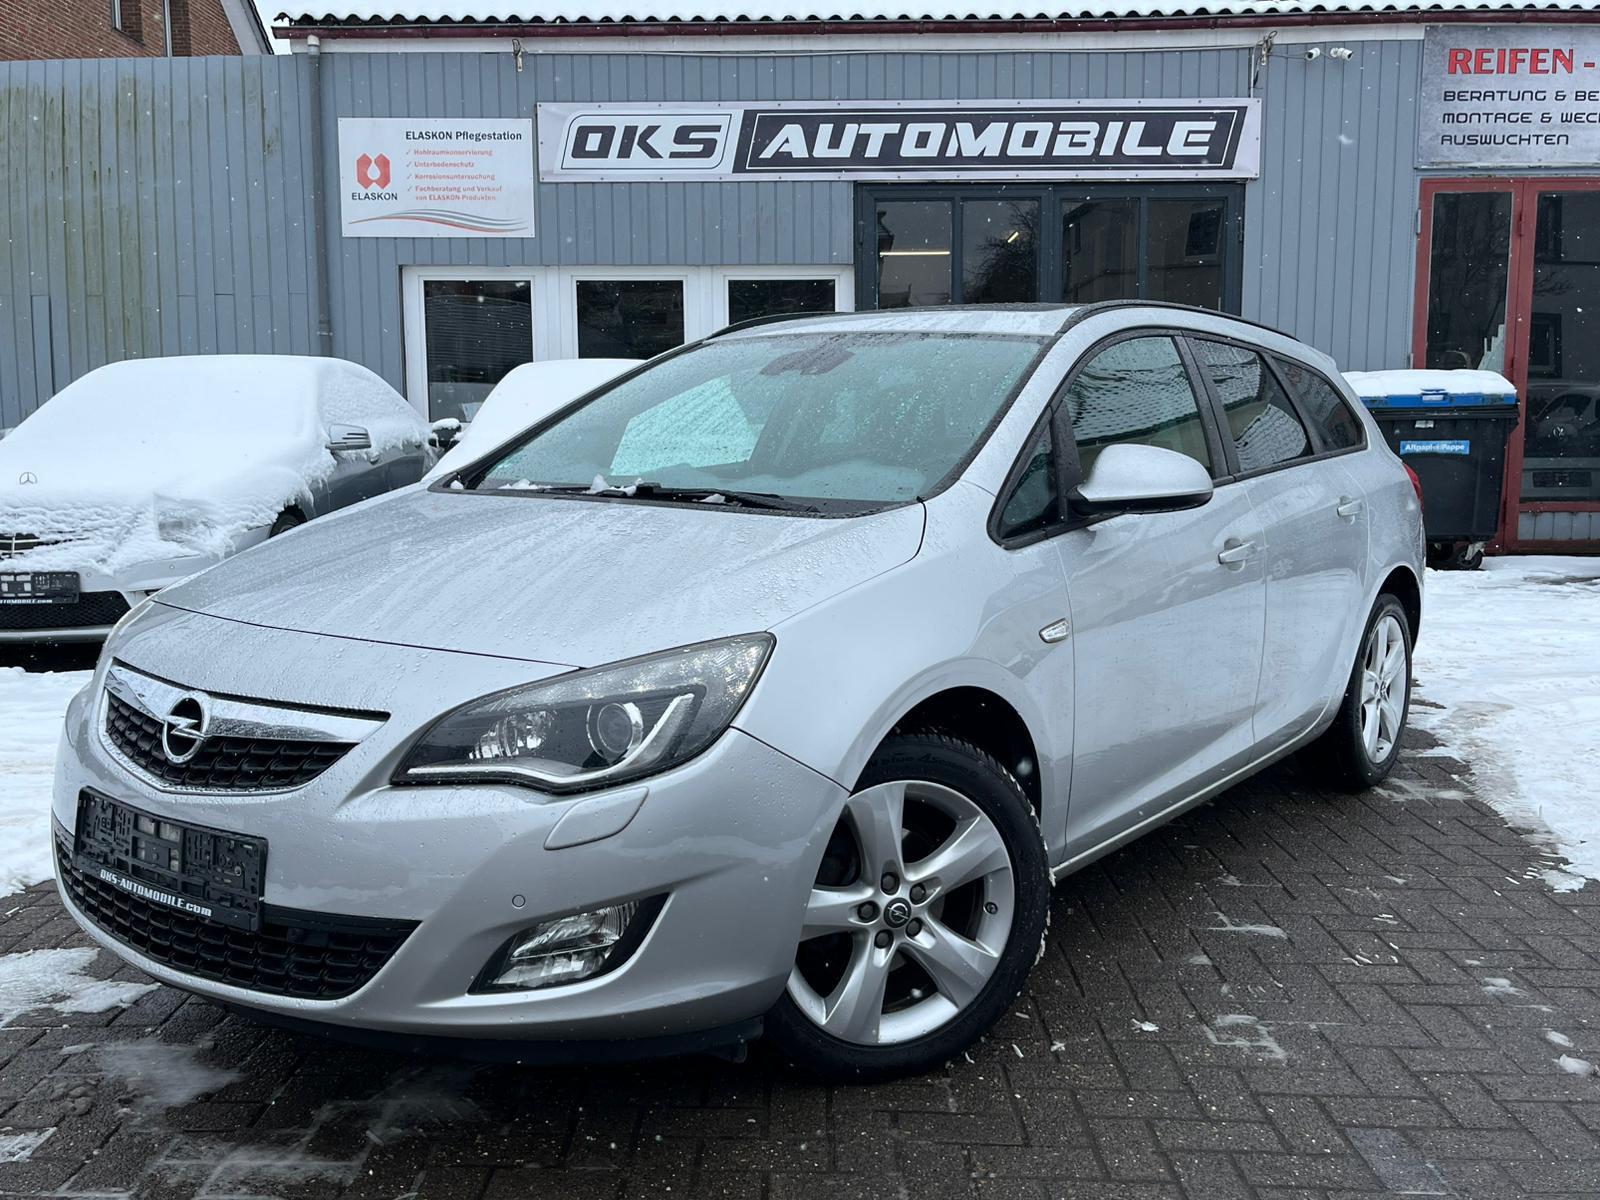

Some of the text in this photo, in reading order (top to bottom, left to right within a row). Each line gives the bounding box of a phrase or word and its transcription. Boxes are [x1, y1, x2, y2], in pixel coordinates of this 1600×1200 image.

[1448, 48, 1574, 74] REIFEN
[1443, 90, 1547, 102] BERATUNG
[1554, 90, 1567, 102] &
[1442, 112, 1600, 124] MONTAGE & WEC
[405, 131, 522, 142] ELASKON Pflegestation
[571, 120, 1219, 160] OKS AUTOMOBILE
[1440, 134, 1570, 146] AUSWUCHTEN
[351, 192, 398, 201] ELASKON
[100, 868, 212, 917] OKS-AUTOMOBILE.com
